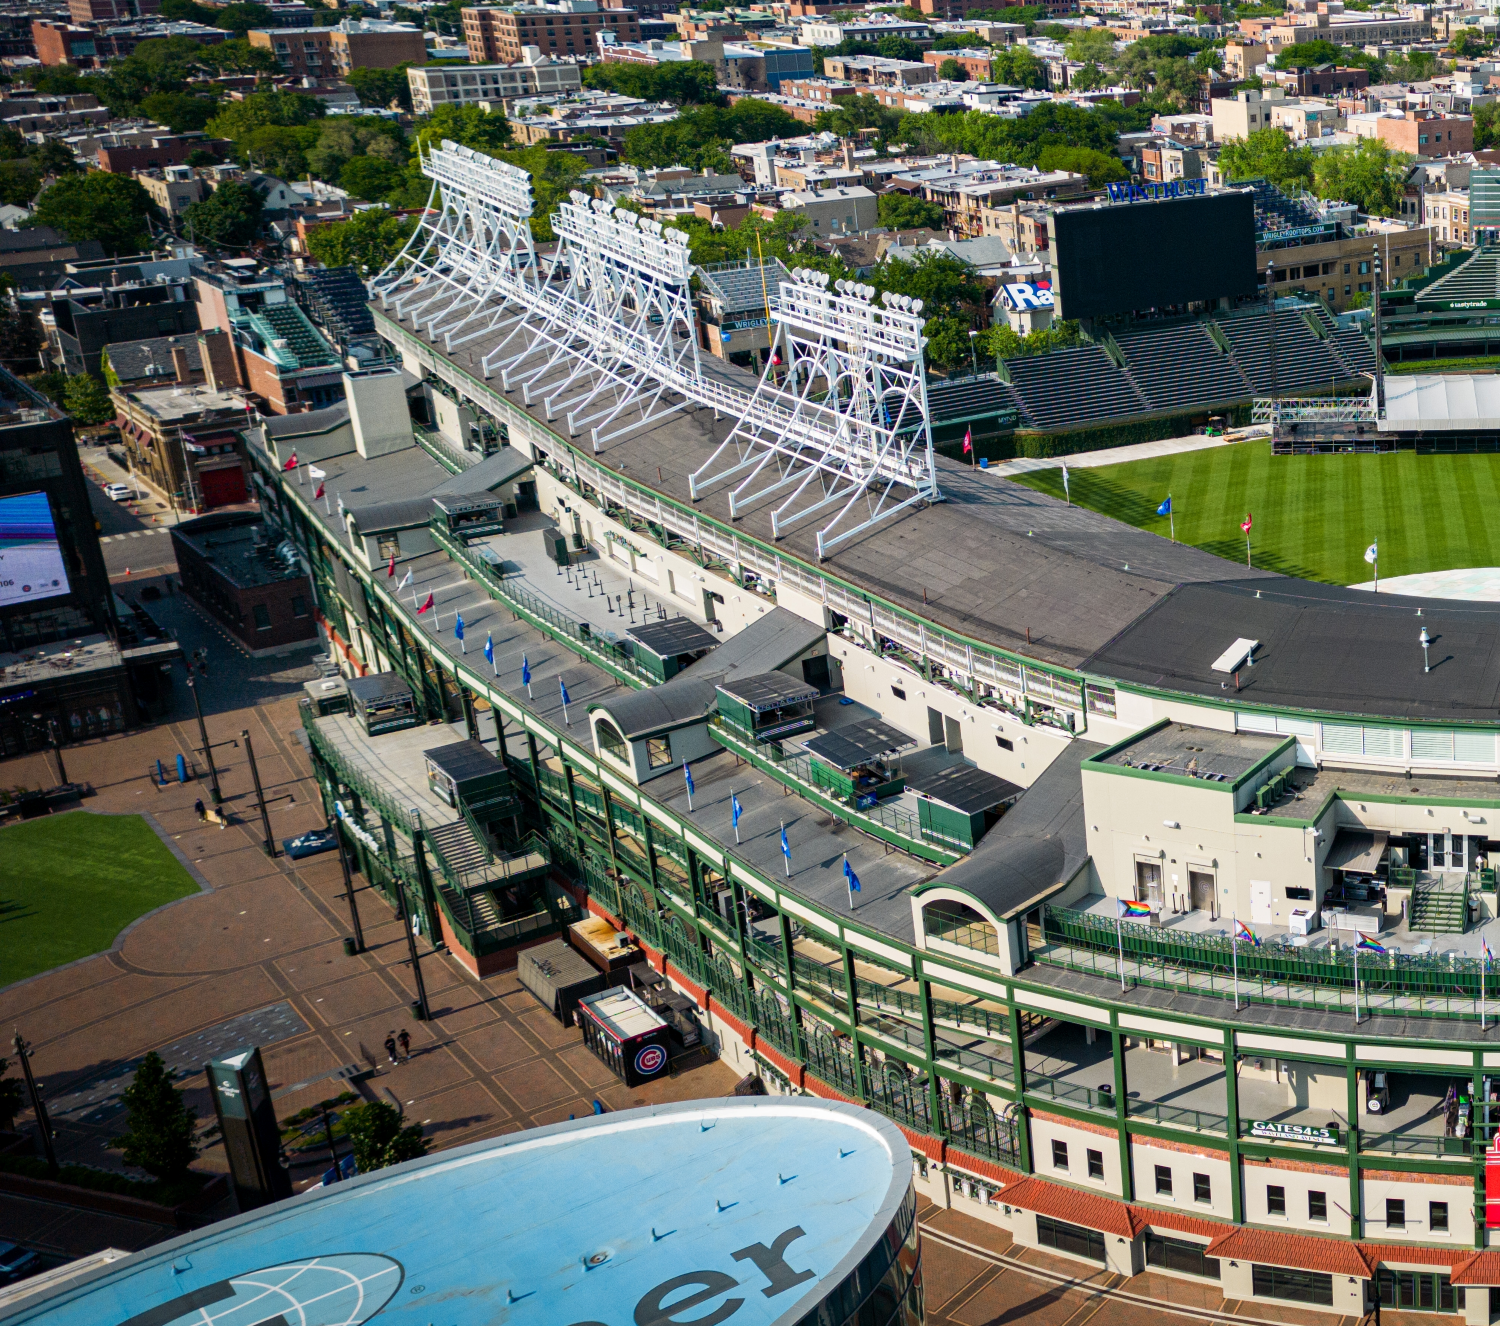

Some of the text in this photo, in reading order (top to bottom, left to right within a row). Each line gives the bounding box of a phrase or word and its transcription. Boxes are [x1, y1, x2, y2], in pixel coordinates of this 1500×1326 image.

[1105, 178, 1209, 203] WINTRUST
[1262, 225, 1326, 241] WRIGLEYROOFTOPS.COM
[1006, 283, 1055, 310] Ra
[1253, 1121, 1303, 1135] GATES
